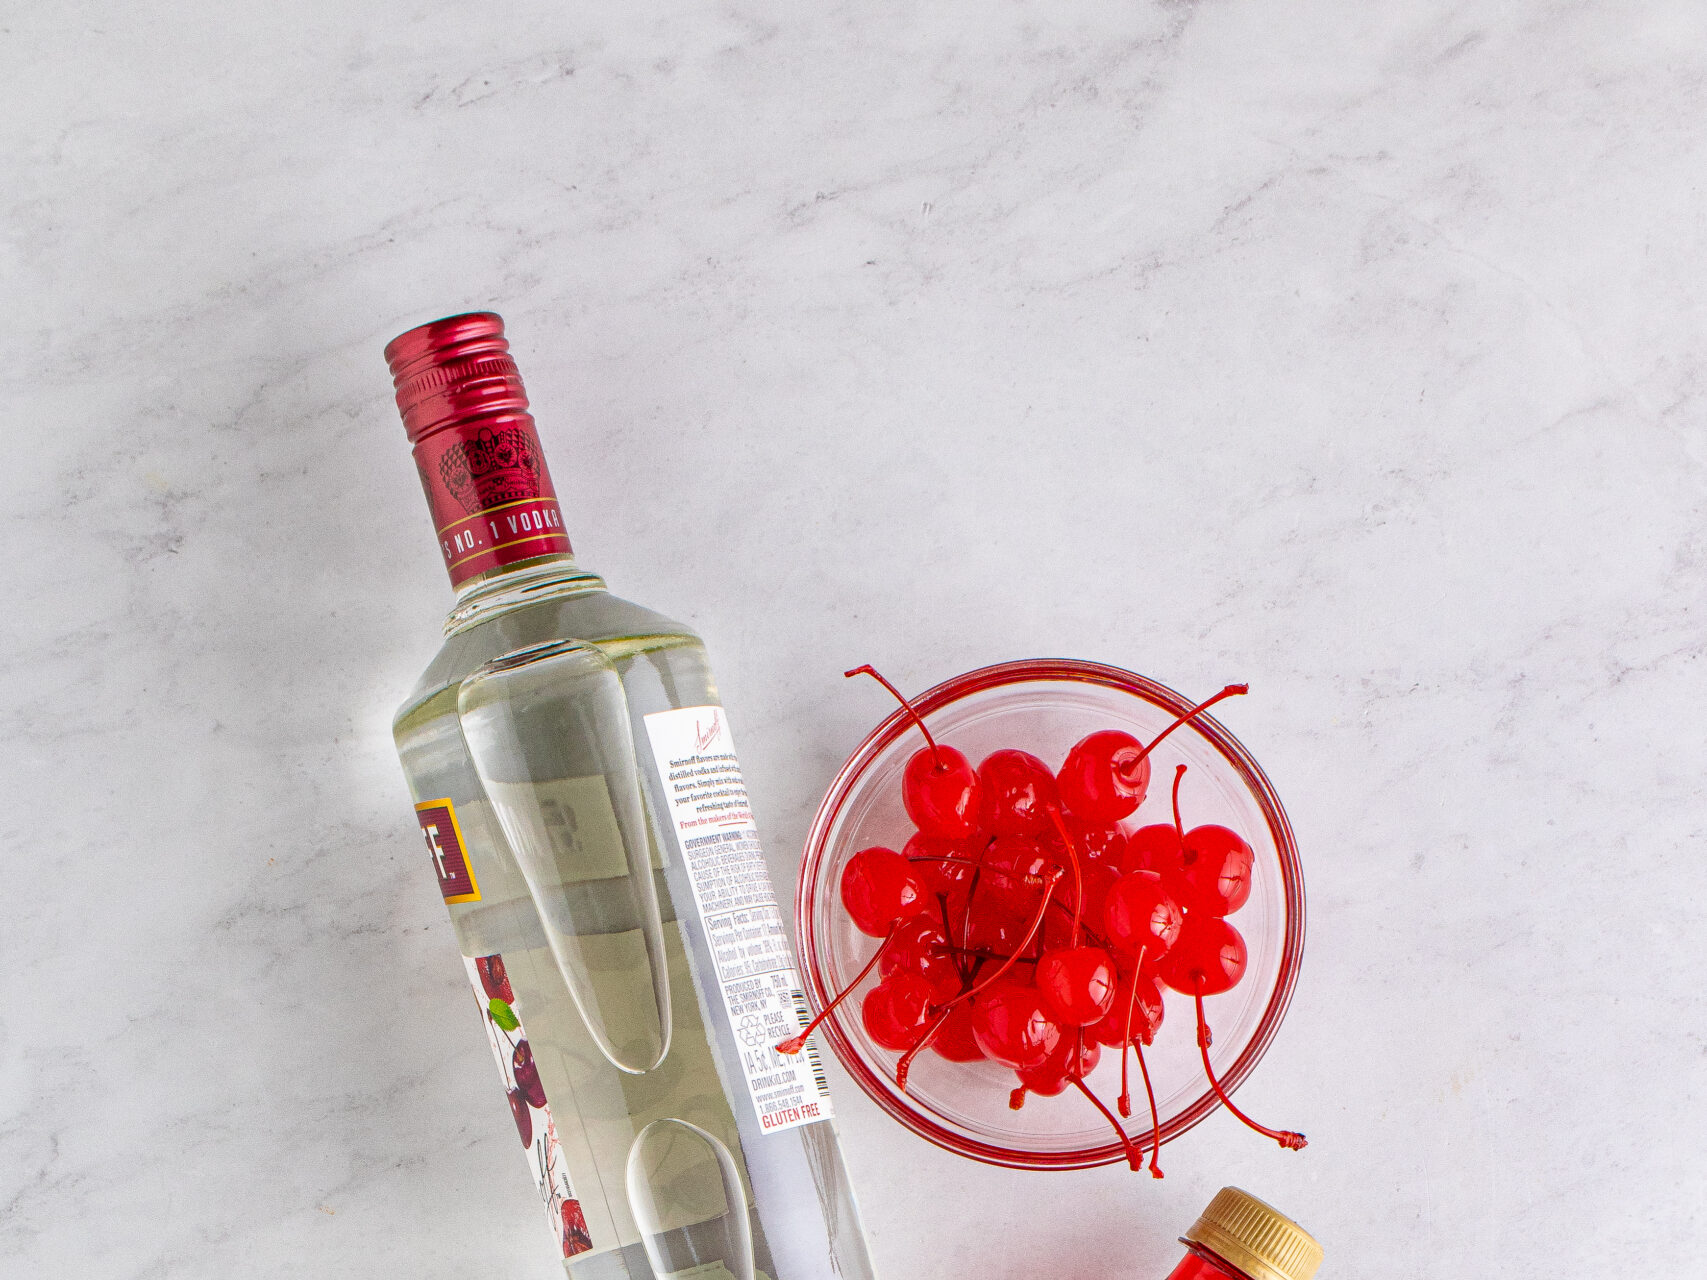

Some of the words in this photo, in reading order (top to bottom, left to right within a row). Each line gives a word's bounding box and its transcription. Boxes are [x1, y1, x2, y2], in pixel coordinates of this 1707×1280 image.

[454, 530, 482, 553] NO.
[490, 521, 499, 538] 1
[507, 509, 559, 534] VODKA
[669, 756, 696, 768] Smirnoff
[669, 769, 694, 781] distilled
[694, 767, 710, 775] vodka
[674, 783, 697, 792] flavors.
[697, 778, 715, 788] Simply
[675, 797, 690, 806] your
[690, 791, 712, 801] favorite
[696, 802, 724, 813] refreshing
[680, 820, 697, 829] From
[698, 817, 708, 825] the
[709, 814, 726, 823] makers
[685, 834, 721, 849] GOVERNMENT
[421, 823, 447, 880] F
[687, 846, 714, 860] SURGEON
[691, 856, 721, 871] ALCOHOLIC
[693, 869, 713, 881] CAUSE
[713, 867, 720, 877] OF
[720, 865, 730, 875] THE
[696, 878, 726, 892] SUMPTION
[726, 876, 732, 886] OF
[699, 891, 716, 903] YOUR
[717, 886, 738, 898] ABILITY
[708, 915, 732, 930] Serving
[725, 981, 754, 995] PRODUCED
[754, 979, 760, 988] BY
[728, 995, 740, 1005] THE
[740, 989, 764, 1003] SMIRNOFF
[731, 1006, 744, 1016] NEW
[760, 999, 767, 1009] NY
[763, 1011, 784, 1025] PLEASE
[767, 1024, 790, 1038] RECYCLE
[756, 1085, 804, 1103] www.smirnoff.com
[762, 1108, 800, 1128] GLUTEN
[801, 1103, 820, 1119] FREE
